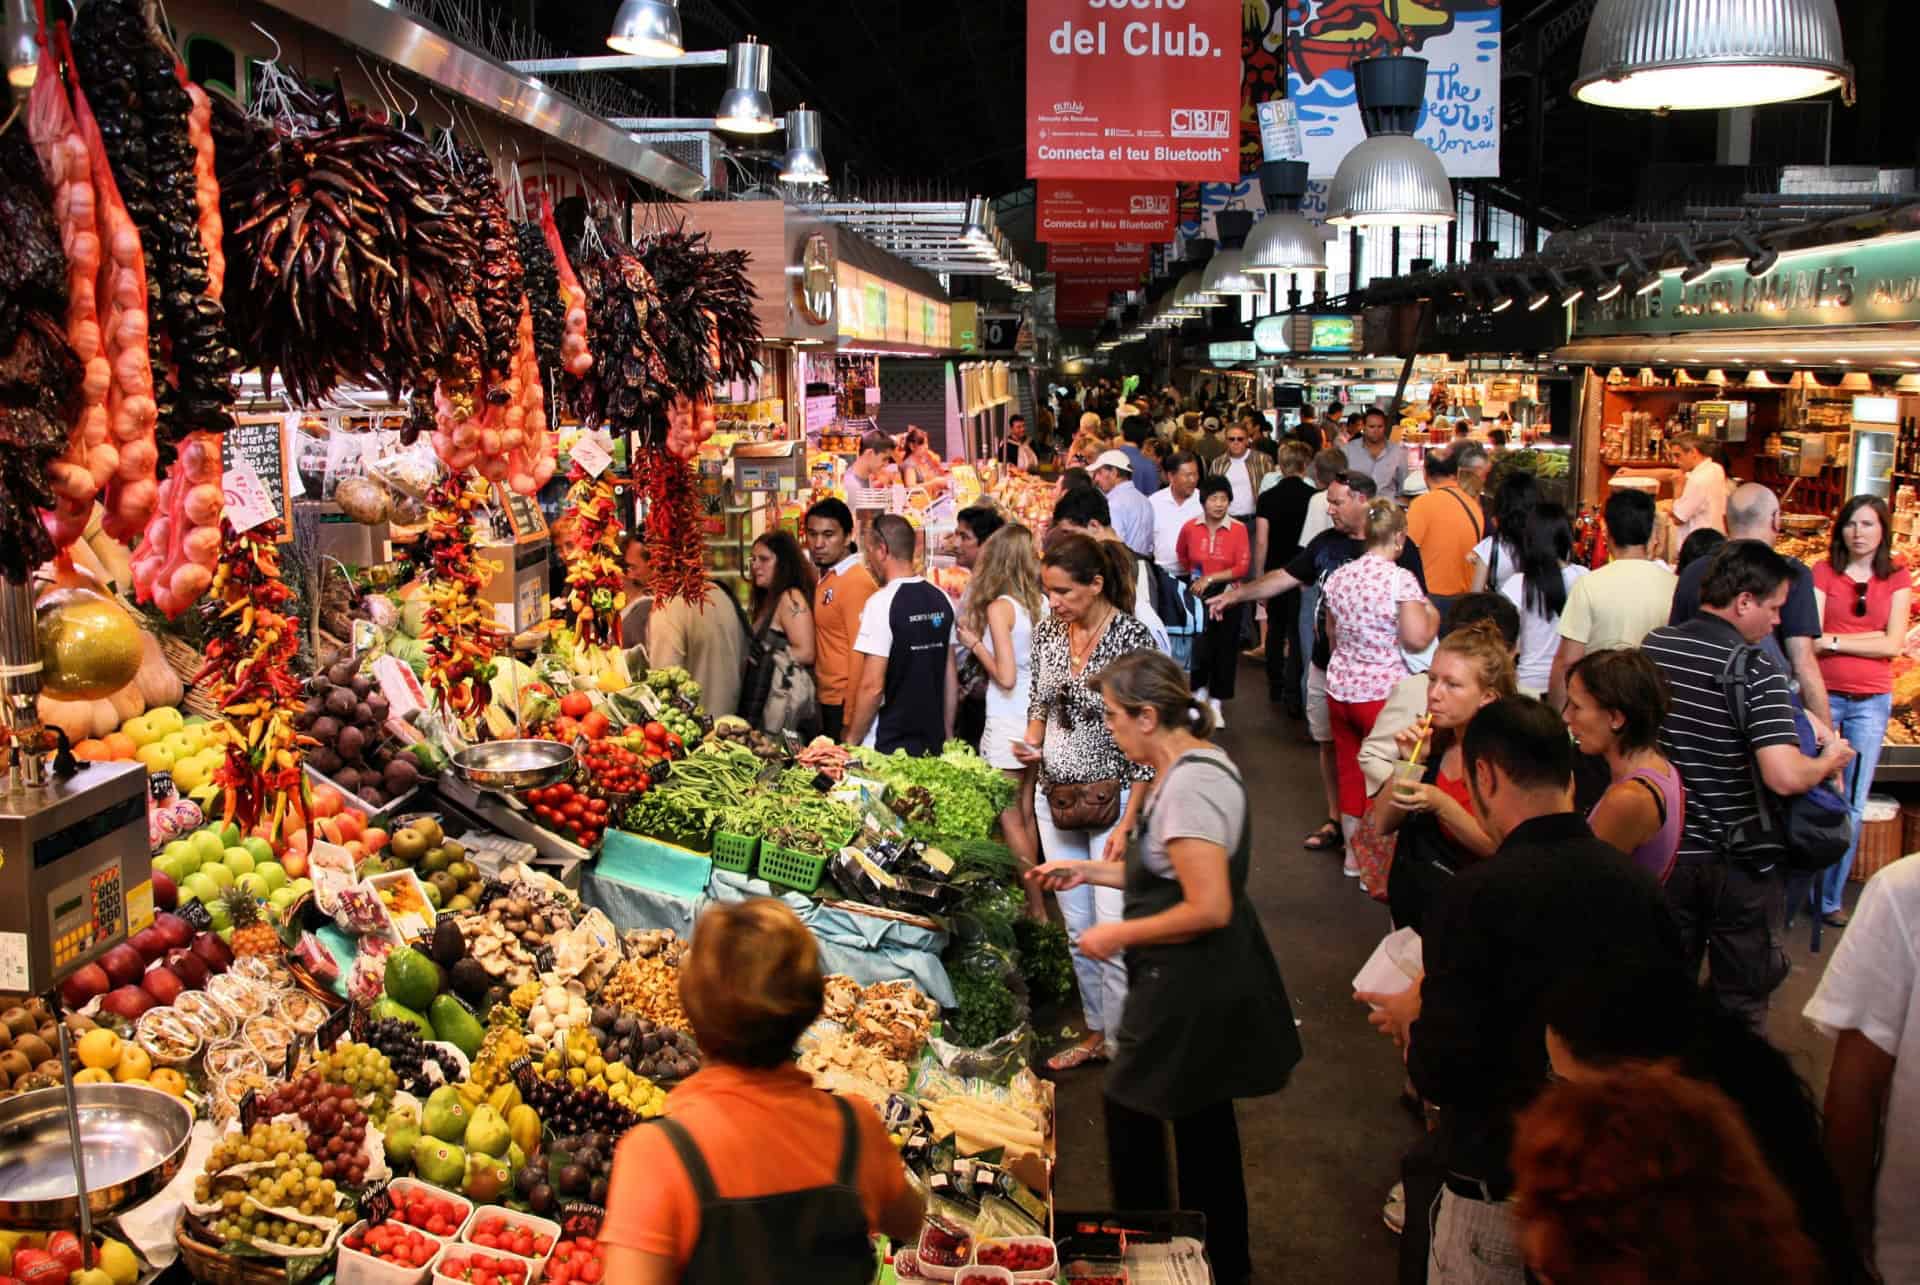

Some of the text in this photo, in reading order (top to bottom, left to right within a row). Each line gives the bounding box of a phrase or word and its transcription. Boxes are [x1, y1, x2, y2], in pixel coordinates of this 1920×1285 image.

[1050, 21, 1221, 56] del Club.
[1426, 63, 1481, 102] The
[1038, 145, 1105, 160] Connecta
[1109, 147, 1122, 160] el
[1127, 147, 1149, 161] teu
[1043, 219, 1088, 229] Connecta
[1089, 219, 1098, 229] el
[1101, 220, 1117, 230] teu
